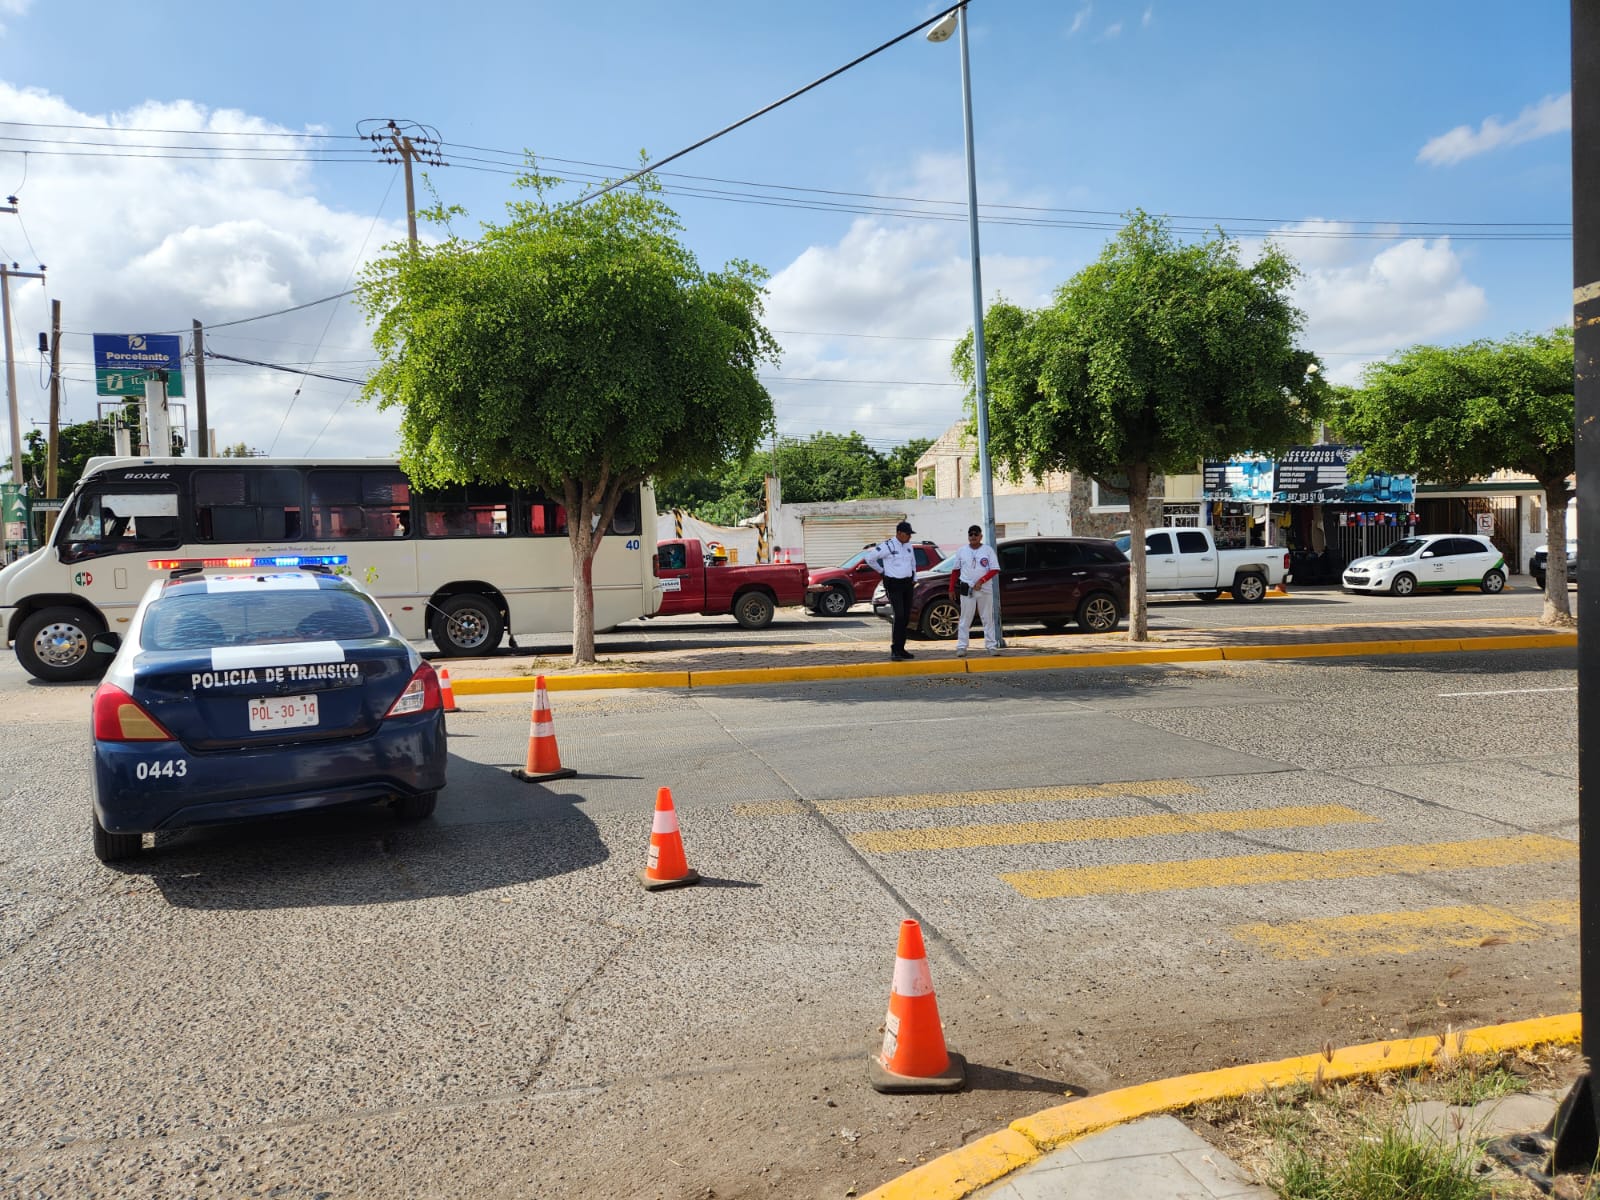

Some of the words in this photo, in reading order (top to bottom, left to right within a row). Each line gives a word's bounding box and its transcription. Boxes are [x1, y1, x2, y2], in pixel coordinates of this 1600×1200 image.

[105, 352, 170, 361] Porcelanite
[625, 540, 640, 550] 40
[191, 670, 258, 689] POLICIA
[265, 668, 285, 683] DE
[288, 663, 359, 681] TRANSITO
[251, 702, 315, 721] POL-30-14
[136, 759, 187, 780] 0443
